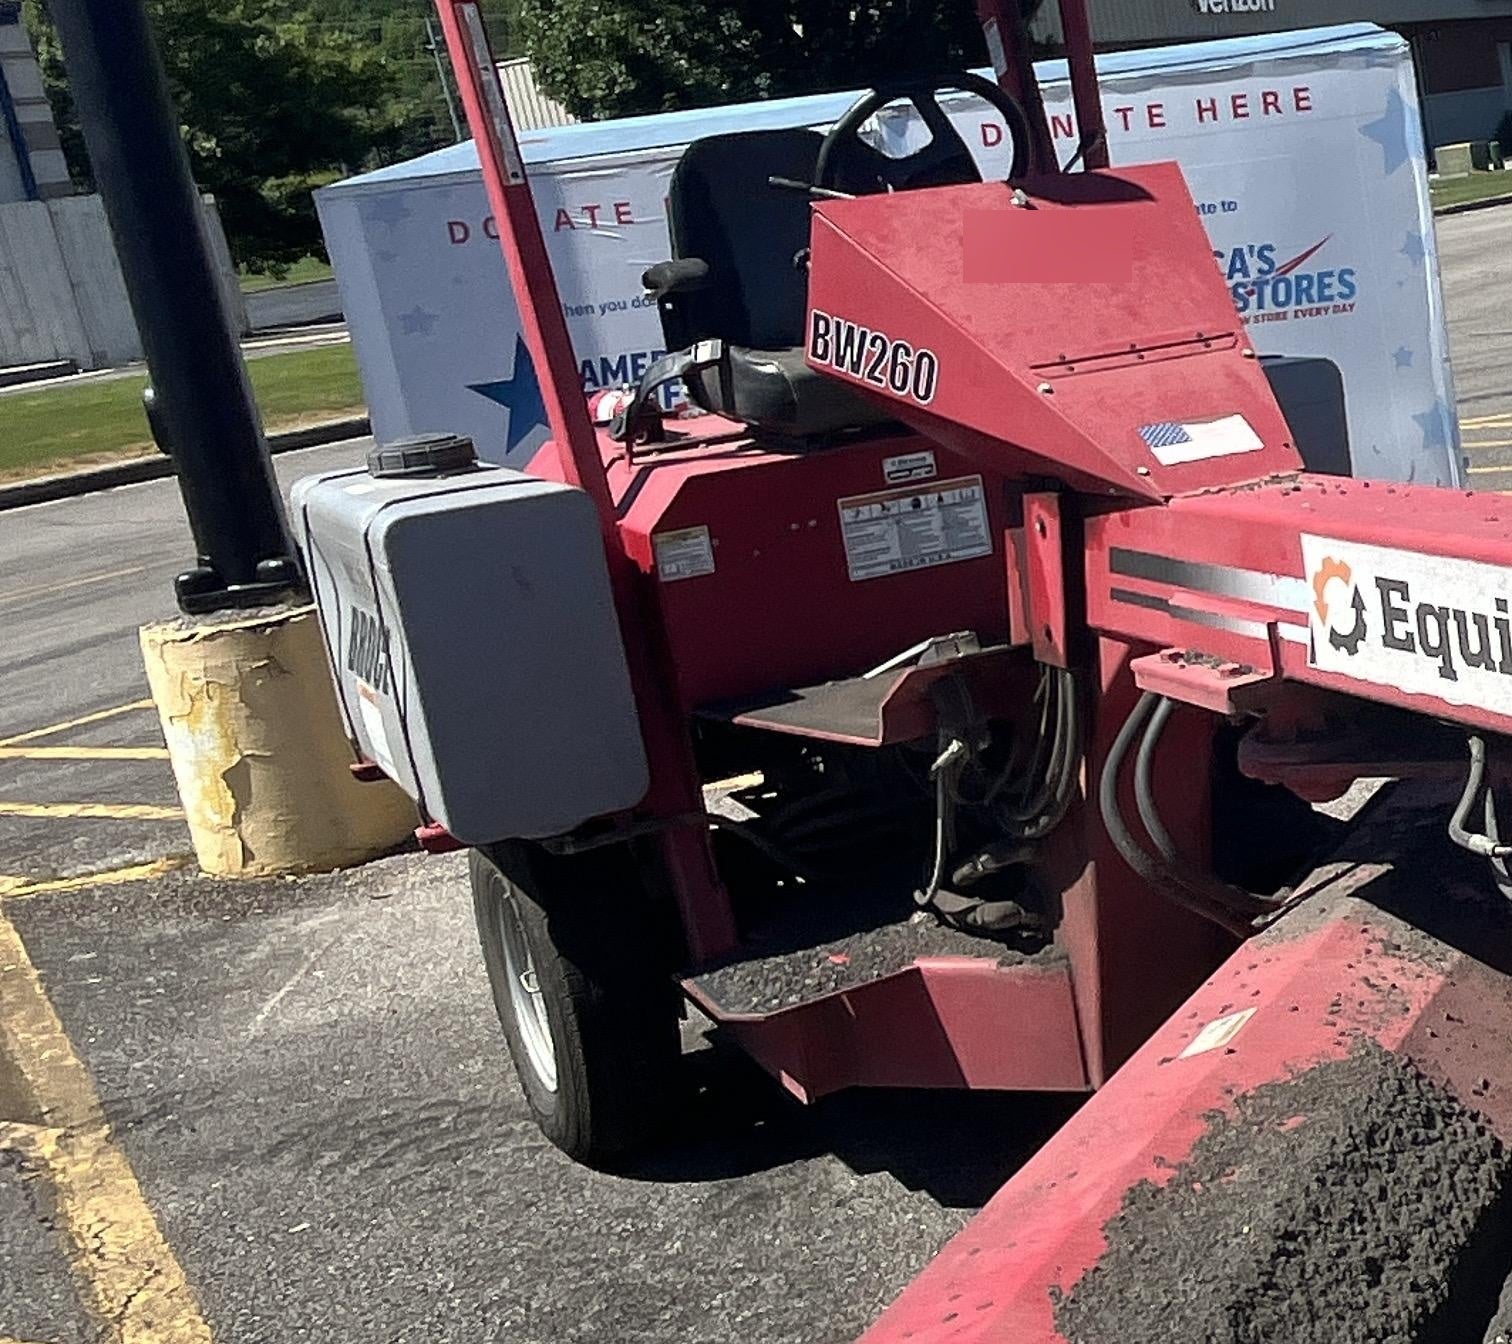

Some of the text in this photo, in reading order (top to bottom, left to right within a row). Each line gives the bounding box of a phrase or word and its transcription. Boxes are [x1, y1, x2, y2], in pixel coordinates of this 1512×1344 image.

[981, 87, 1313, 147] DNTE HERE
[448, 202, 634, 244] DOATE
[1221, 200, 1238, 212] to
[1213, 244, 1276, 280] A'S
[564, 303, 595, 318] hen
[600, 301, 627, 316] you
[1231, 268, 1357, 312] STORES
[1293, 306, 1329, 319] EVERY
[1332, 303, 1355, 314] DAY
[808, 308, 938, 405] BW260
